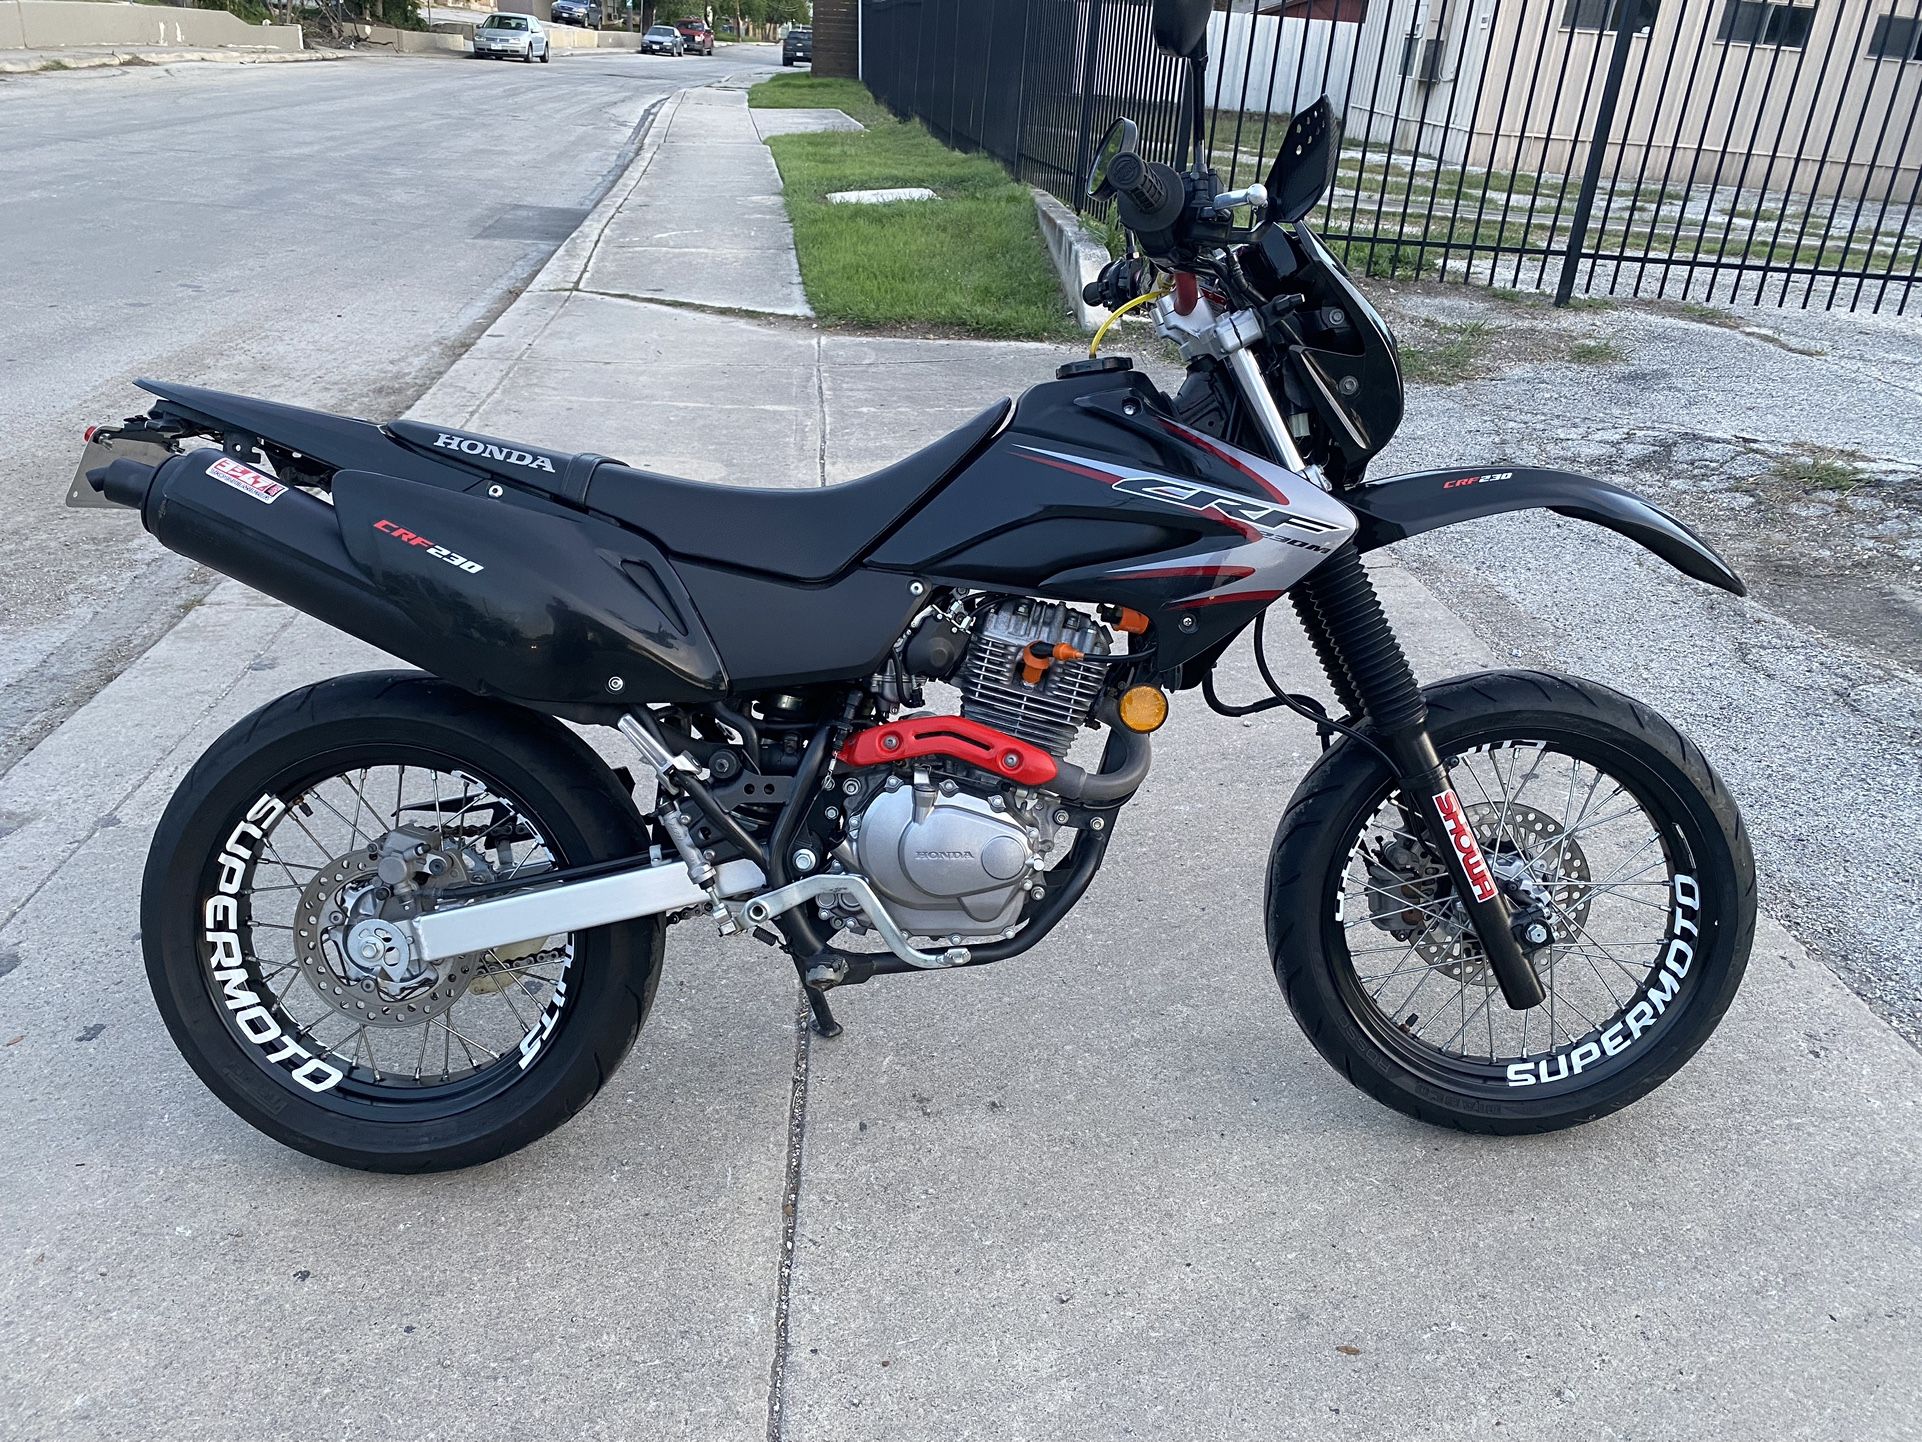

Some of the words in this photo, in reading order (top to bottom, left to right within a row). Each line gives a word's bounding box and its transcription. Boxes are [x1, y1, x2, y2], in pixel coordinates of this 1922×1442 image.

[433, 433, 556, 473] HONDA
[1443, 472, 1513, 489] CRF230
[1112, 477, 1349, 535] CRF
[373, 519, 485, 574] CRF230
[1259, 530, 1332, 555] 230M
[914, 851, 975, 861] HONDA
[1434, 790, 1496, 901] SHOWA
[205, 793, 343, 1093] SUPERMOTO
[1506, 874, 1700, 1087] SUPERMOTO
[1337, 1014, 1393, 1074] ROSSO
